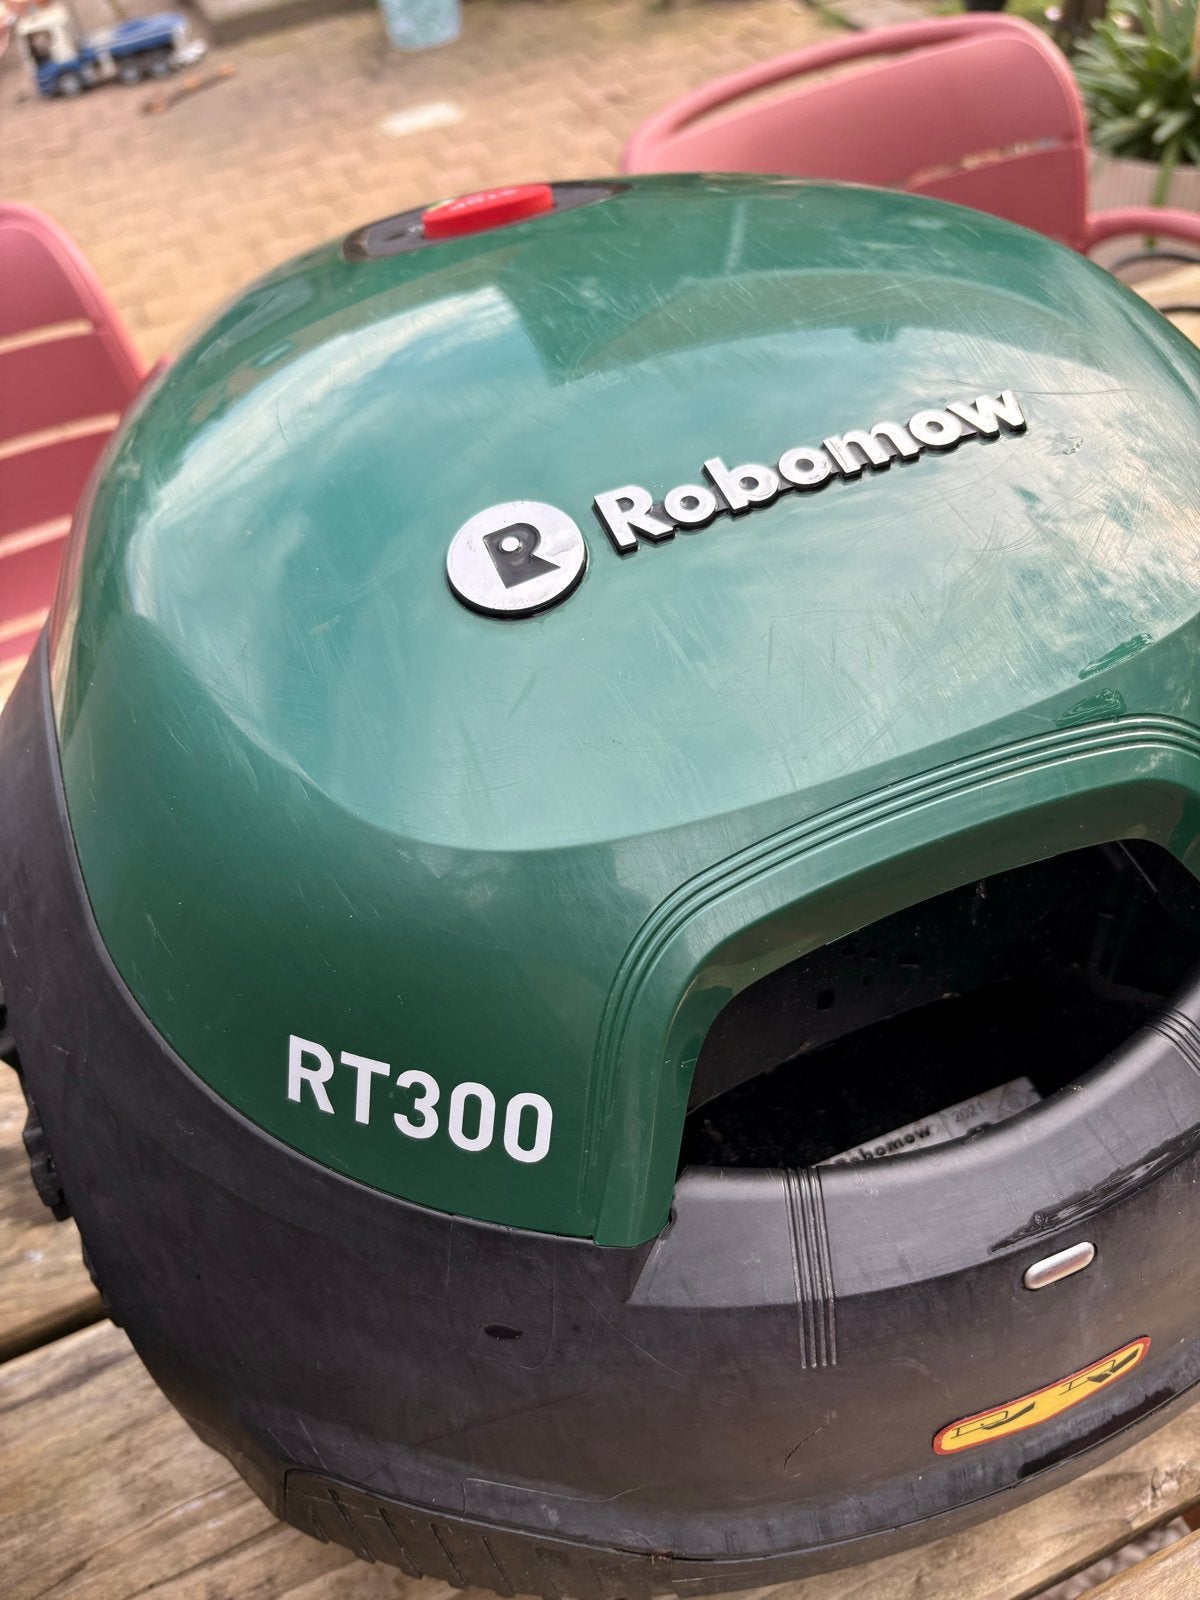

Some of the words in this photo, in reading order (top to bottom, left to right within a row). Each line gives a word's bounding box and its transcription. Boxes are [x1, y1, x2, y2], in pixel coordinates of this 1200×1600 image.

[593, 389, 1027, 554] Robomow
[482, 522, 561, 589] R
[287, 1034, 553, 1163] RT300
